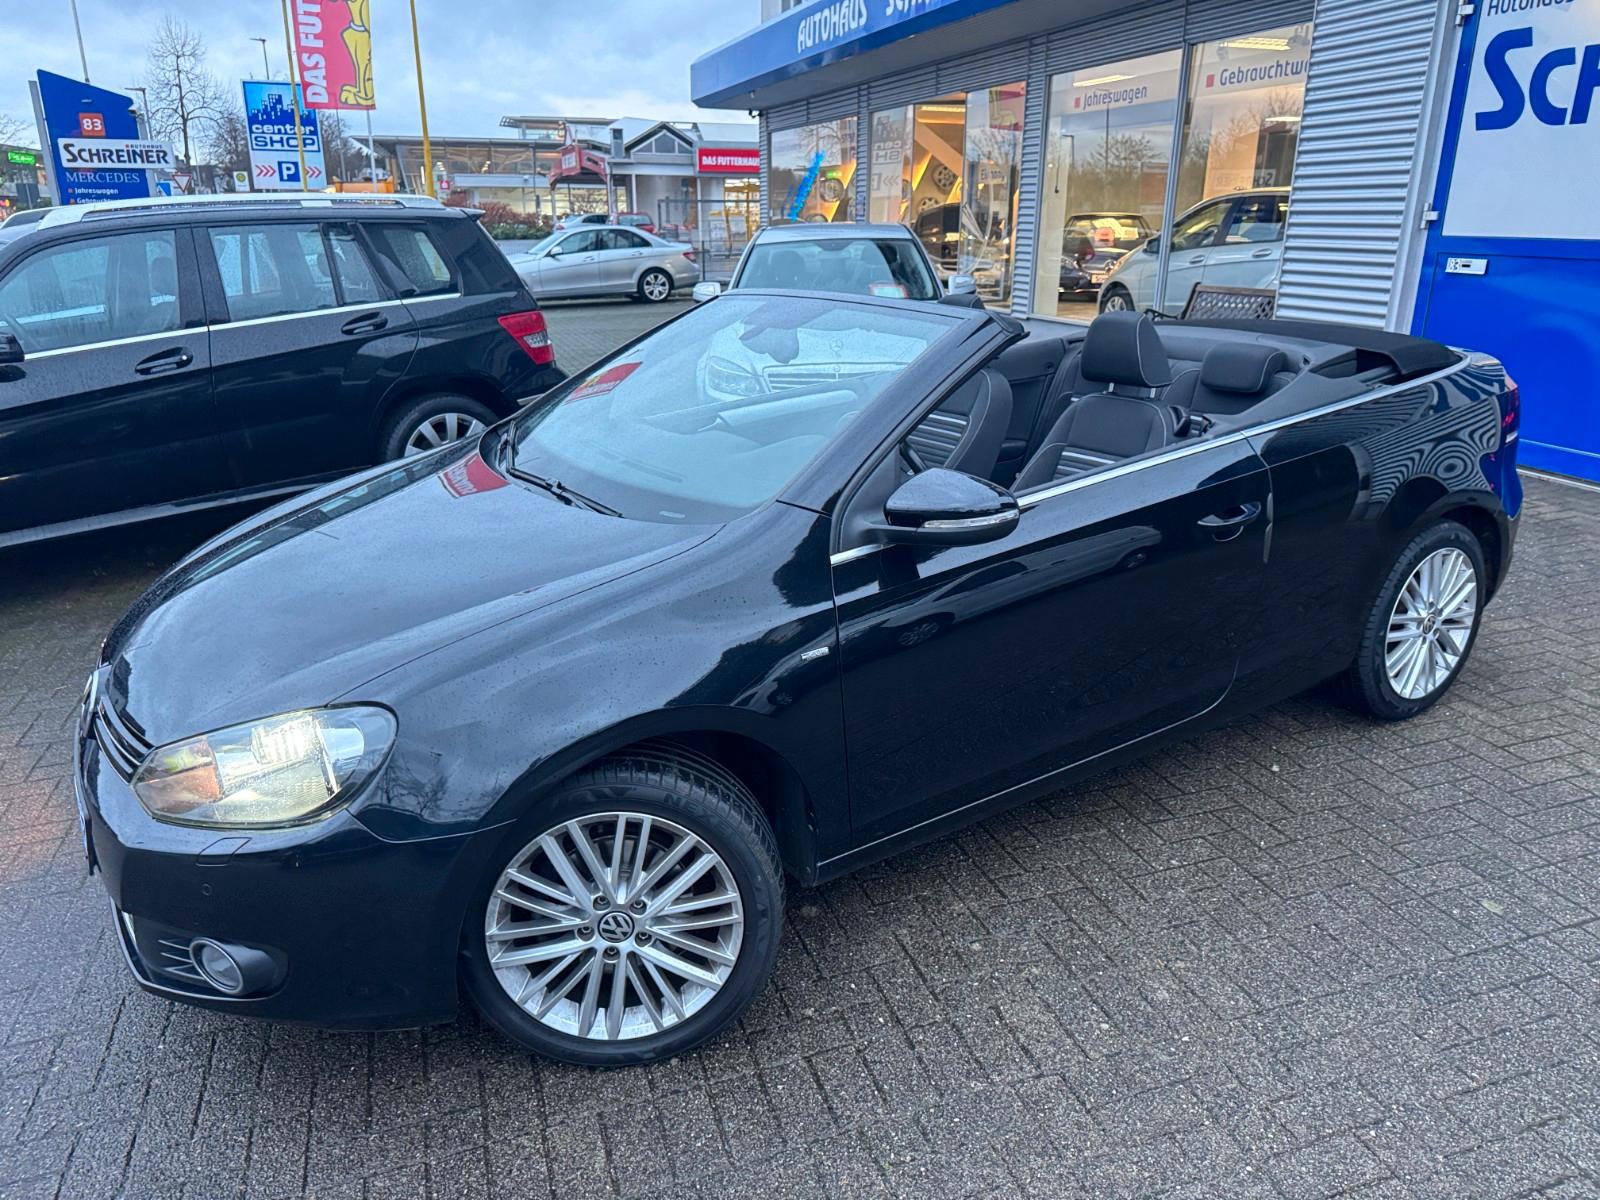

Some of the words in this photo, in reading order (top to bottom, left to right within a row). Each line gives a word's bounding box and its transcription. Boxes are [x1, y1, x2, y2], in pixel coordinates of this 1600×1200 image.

[797, 0, 867, 54] AUTOHAUS
[302, 53, 329, 103] DAS
[1083, 85, 1148, 110] Jahreswagen
[82, 118, 102, 131] 83
[251, 123, 315, 135] center
[253, 135, 316, 149] SHOP
[63, 143, 169, 164] SCHREINER
[702, 156, 716, 165] DAS
[65, 172, 141, 183] MERCEDES
[281, 163, 296, 180] P
[75, 187, 119, 195] Jahreswagen
